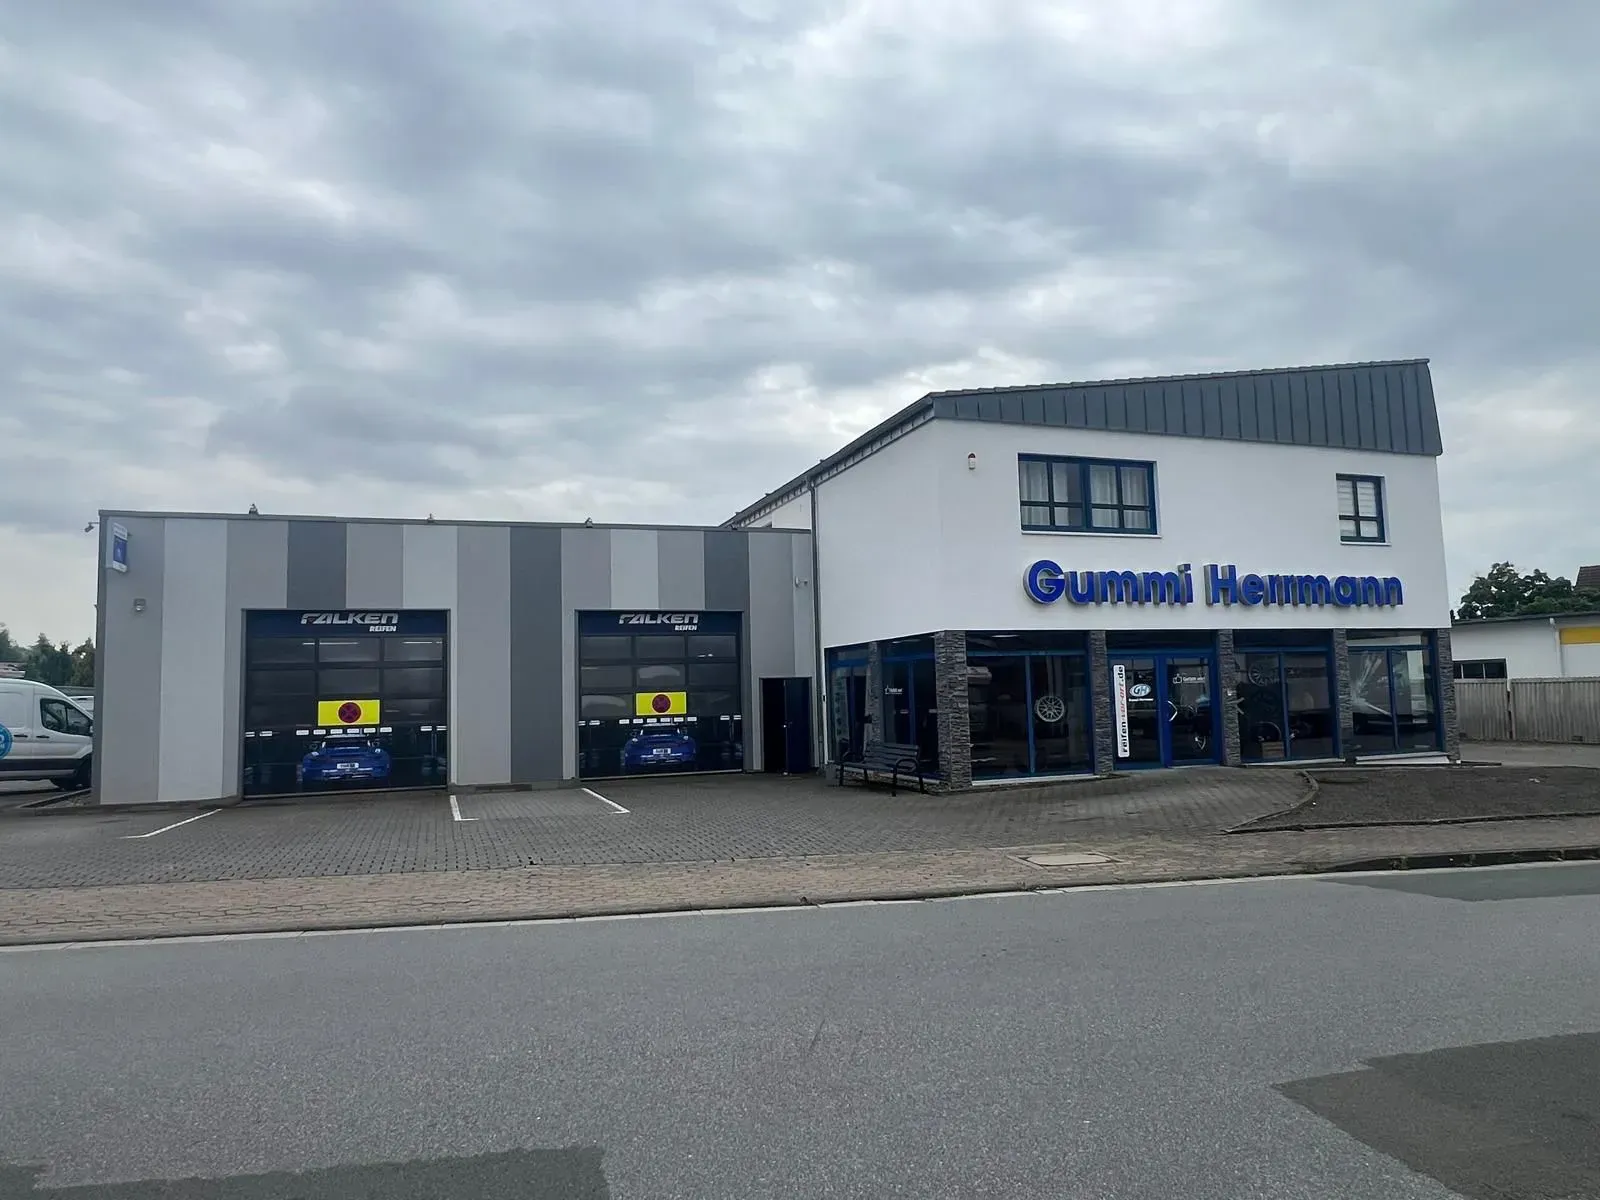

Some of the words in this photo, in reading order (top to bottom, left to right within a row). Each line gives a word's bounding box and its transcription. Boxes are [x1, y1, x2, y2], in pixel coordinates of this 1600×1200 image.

[1023, 559, 1194, 606] Gummi
[1203, 564, 1404, 607] Herrmann
[300, 612, 399, 625] FALKEN
[618, 613, 699, 625] FALKEN
